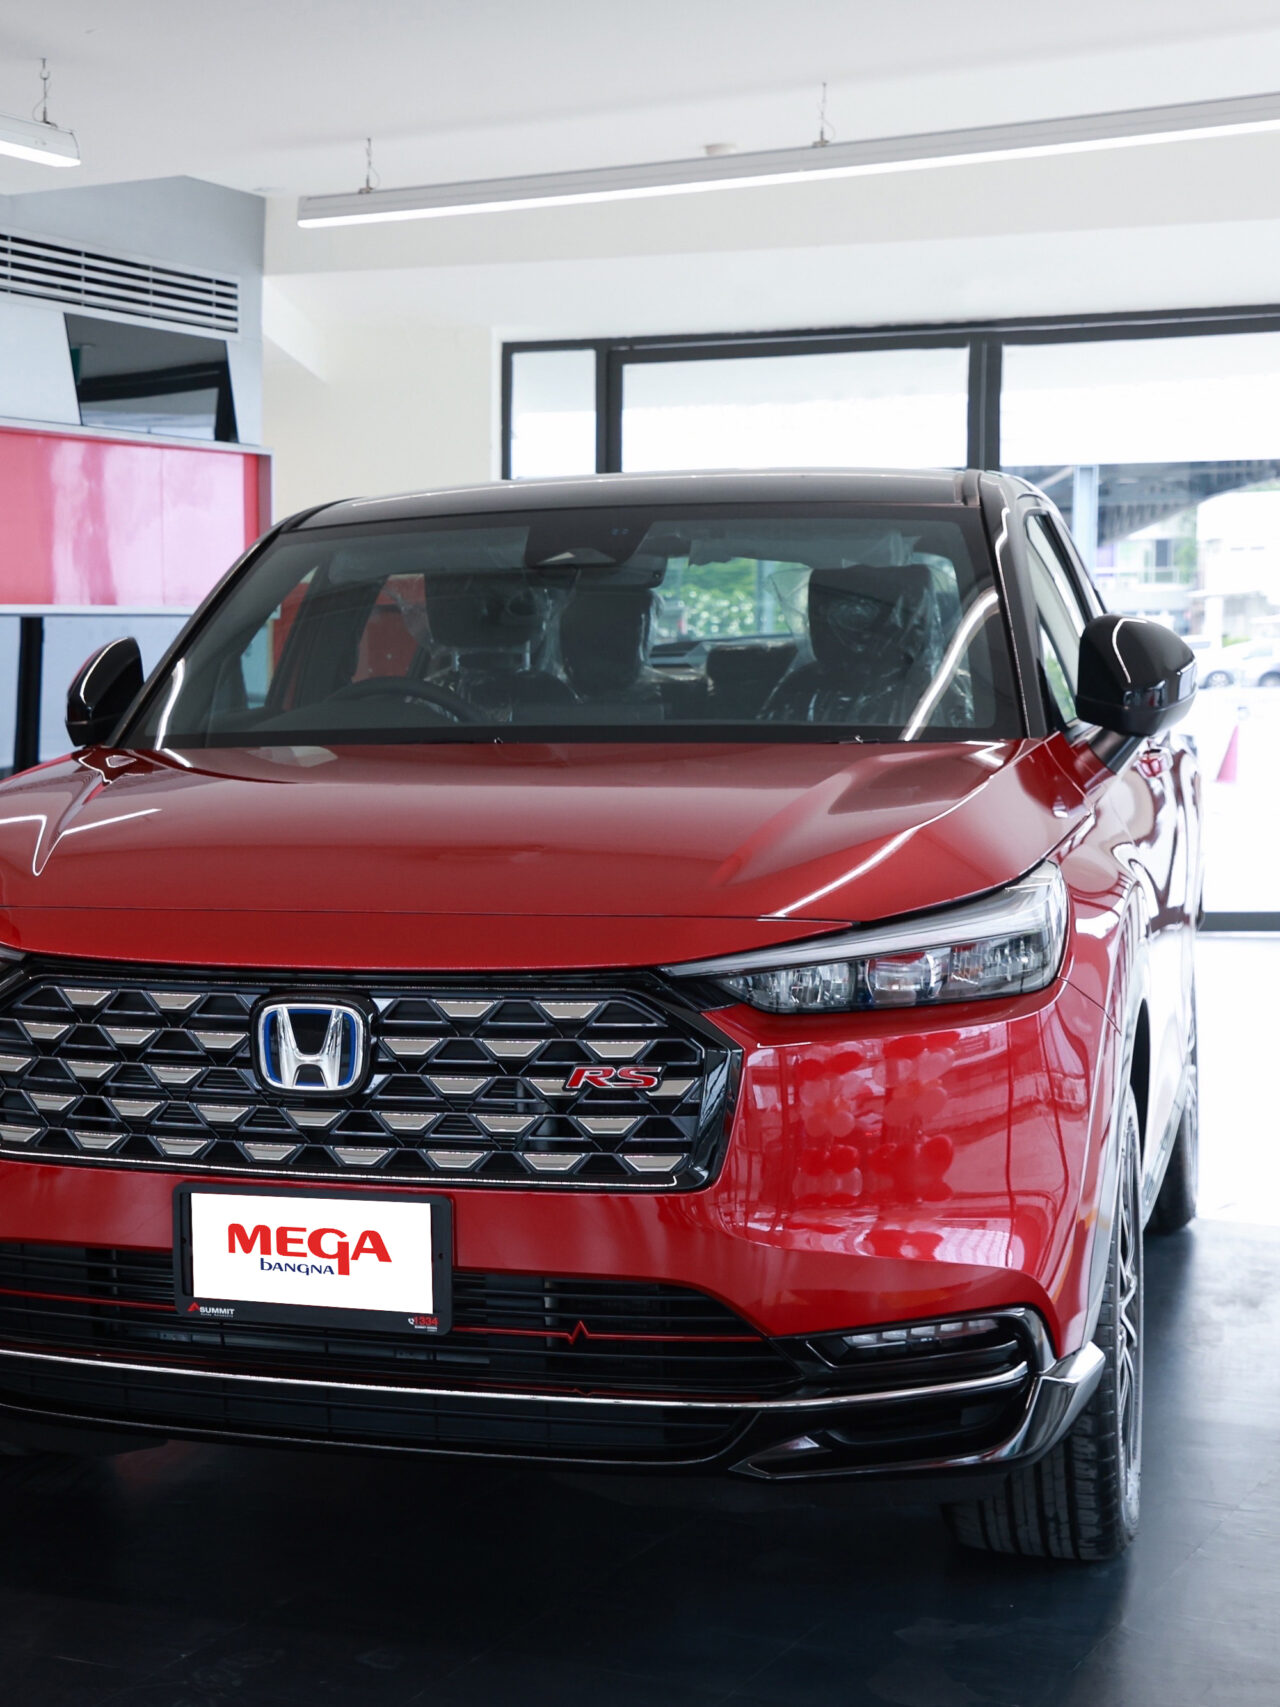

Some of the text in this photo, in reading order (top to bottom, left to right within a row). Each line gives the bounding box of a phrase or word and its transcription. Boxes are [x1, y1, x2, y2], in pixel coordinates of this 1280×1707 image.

[567, 1064, 664, 1090] RS
[227, 1223, 393, 1276] MEGA
[199, 1306, 235, 1315] SUMMIT
[414, 1316, 439, 1326] 1334
